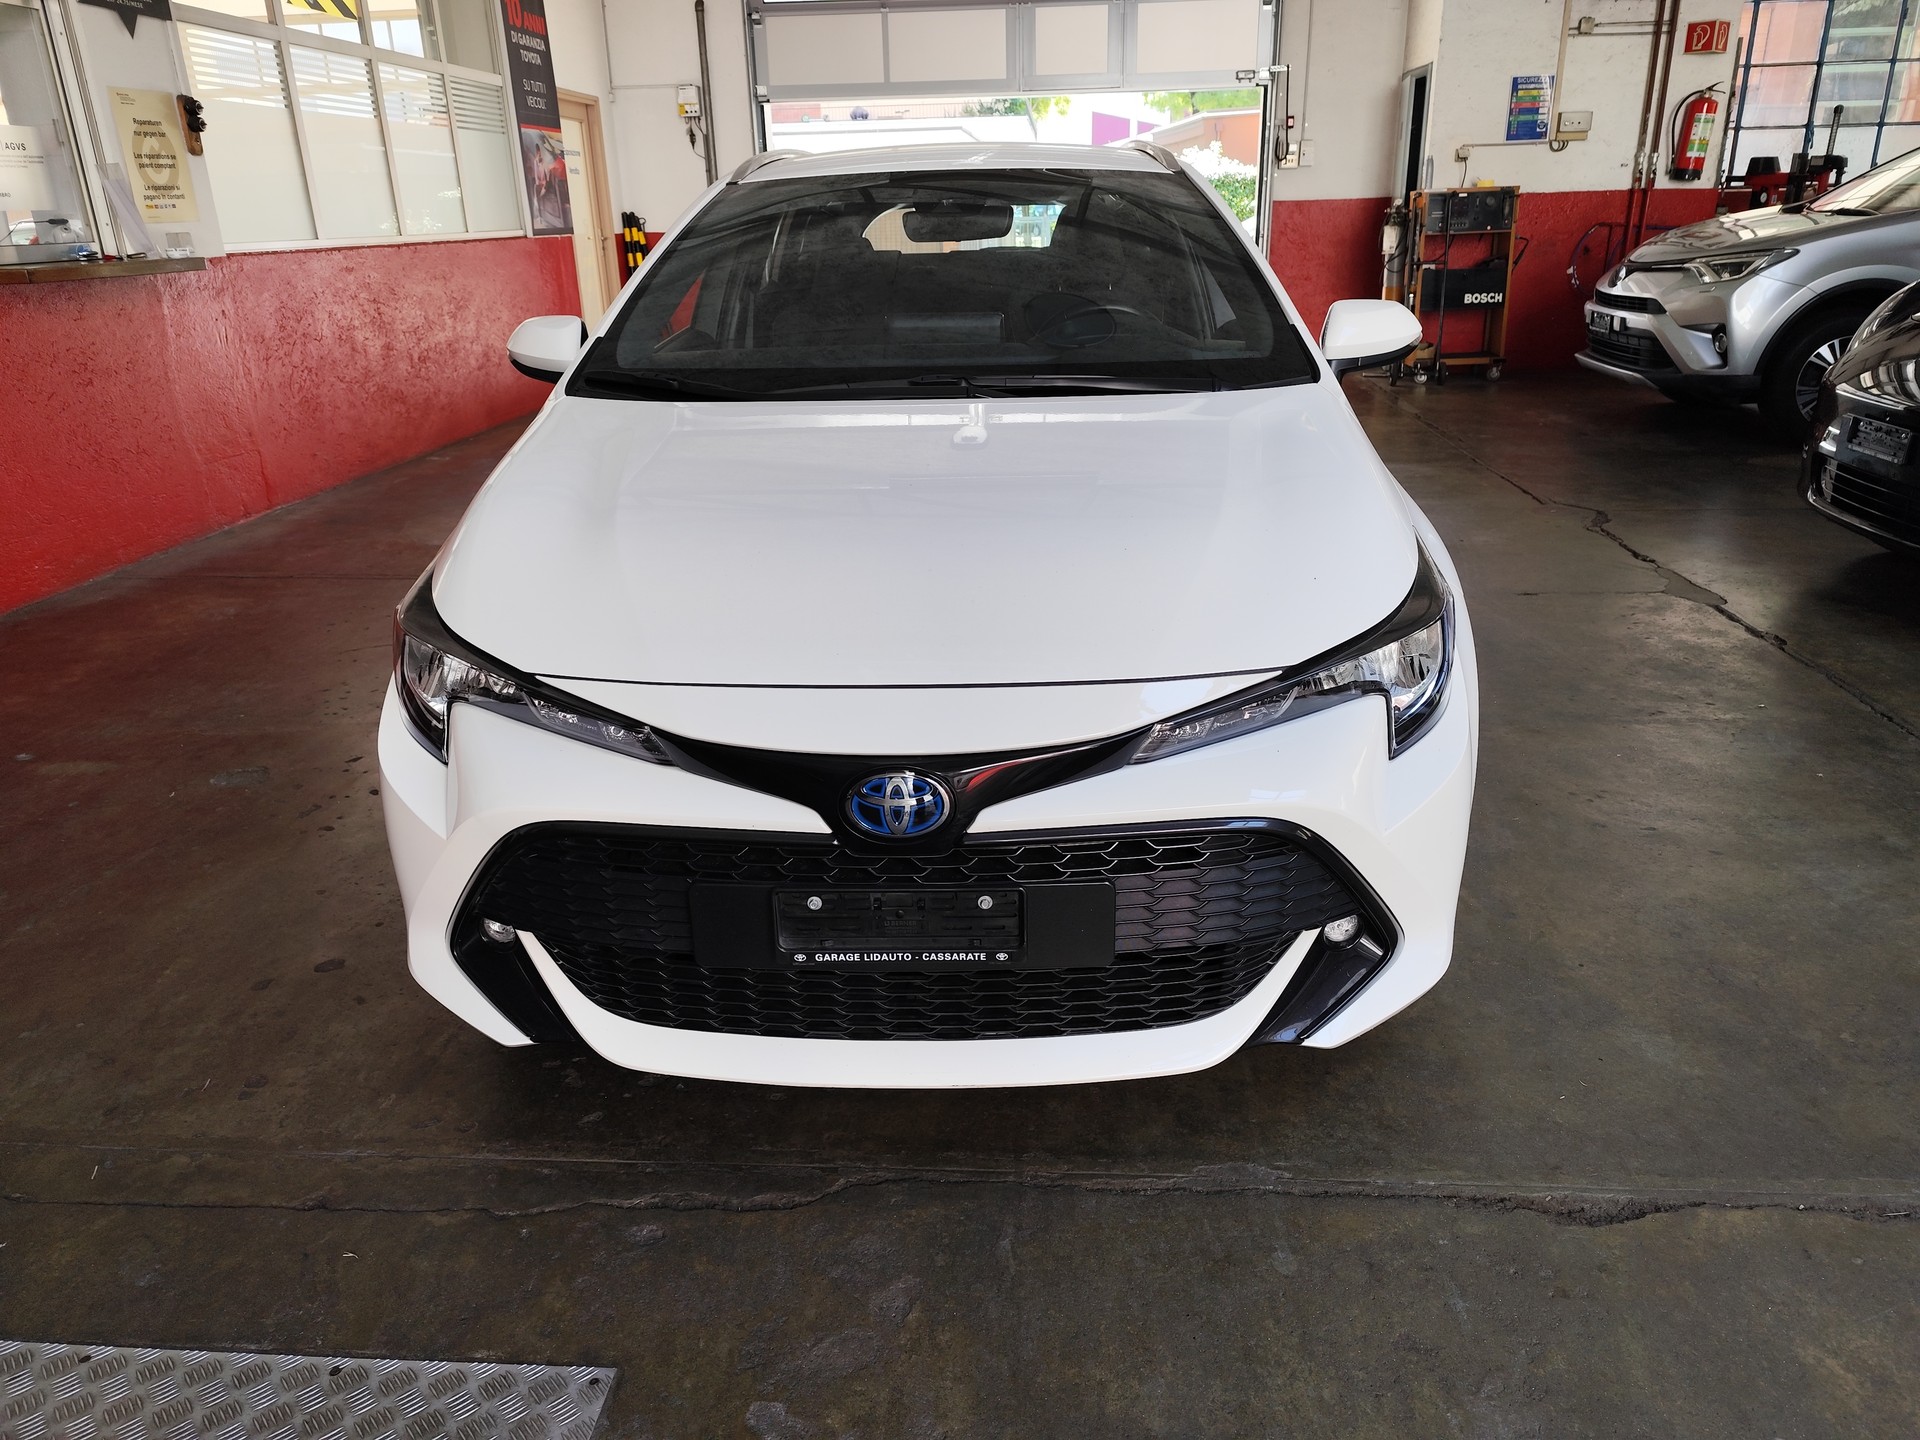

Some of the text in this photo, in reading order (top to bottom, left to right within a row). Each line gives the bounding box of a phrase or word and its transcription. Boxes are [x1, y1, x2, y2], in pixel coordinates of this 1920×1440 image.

[504, 0, 546, 35] 10 ANNI
[510, 30, 546, 52] DI GARANZIA
[520, 49, 542, 66] TOYOTA
[522, 79, 530, 91] SU
[530, 80, 544, 93] TUTTI
[133, 117, 162, 127] Reparaturen
[158, 130, 166, 138] bar
[4, 142, 27, 151] AGVS
[143, 152, 169, 160] réparations
[138, 162, 154, 170] paient
[143, 194, 161, 202] pagano
[1464, 292, 1503, 304] BOSCH
[815, 953, 860, 962] GARAGE
[864, 953, 912, 962] LIDAUTO
[922, 952, 987, 961] CASSARATE
